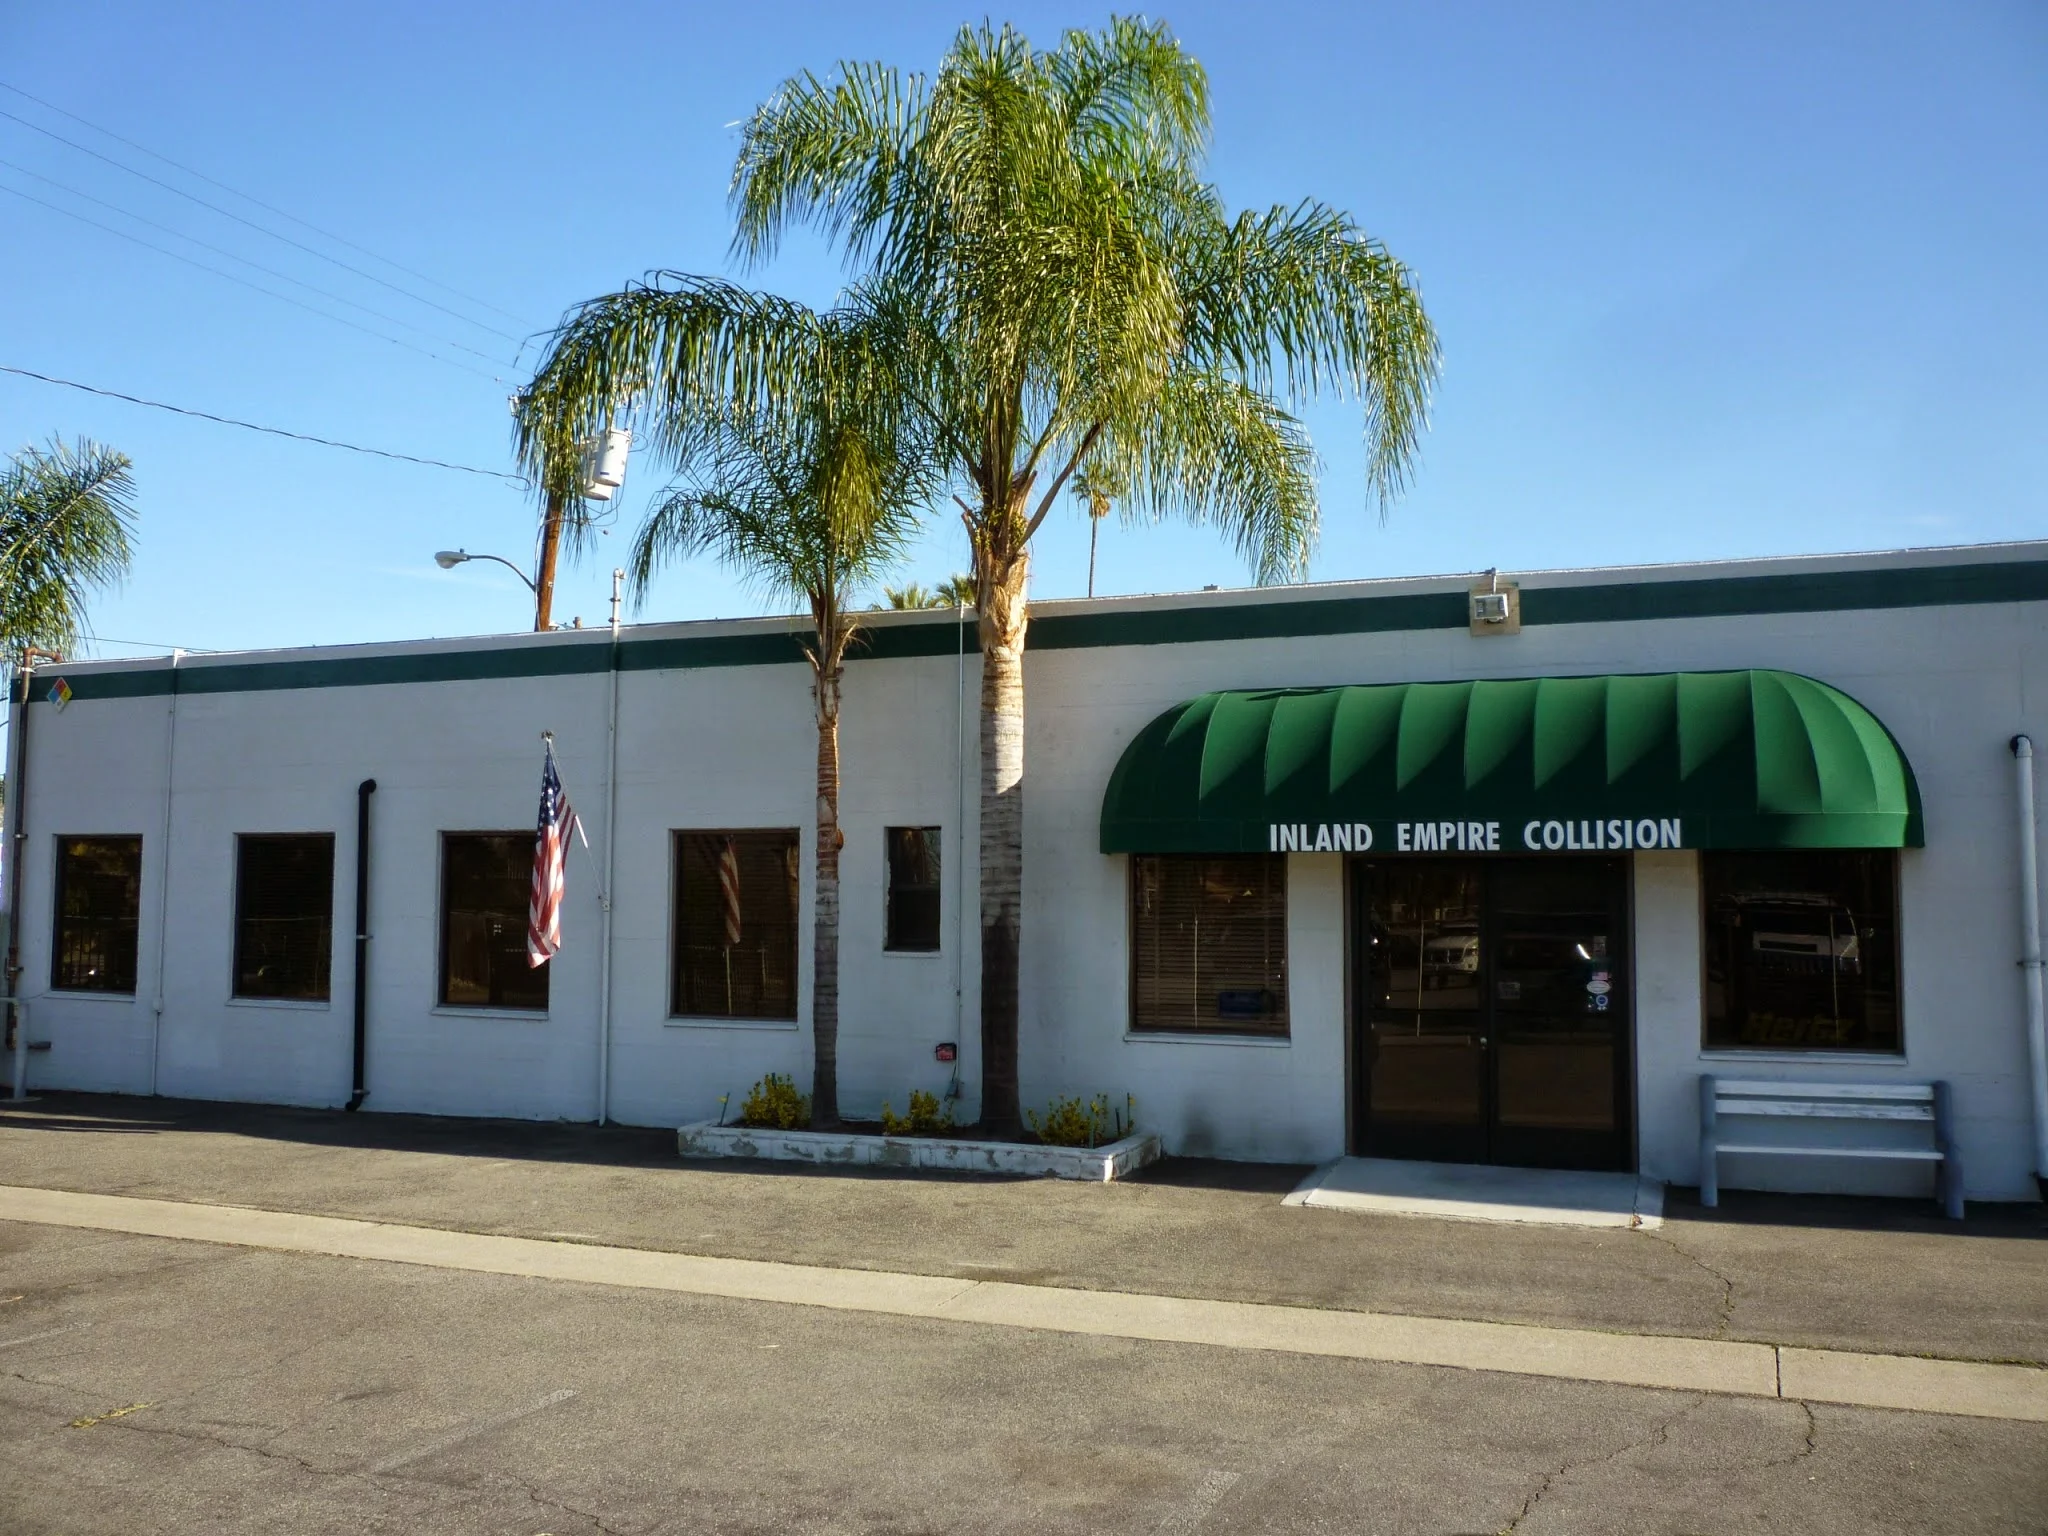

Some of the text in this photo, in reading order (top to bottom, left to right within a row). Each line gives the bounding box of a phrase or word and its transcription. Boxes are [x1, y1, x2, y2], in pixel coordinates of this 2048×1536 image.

[1269, 818, 1682, 852] INLAND EMPIRE COLLISION
